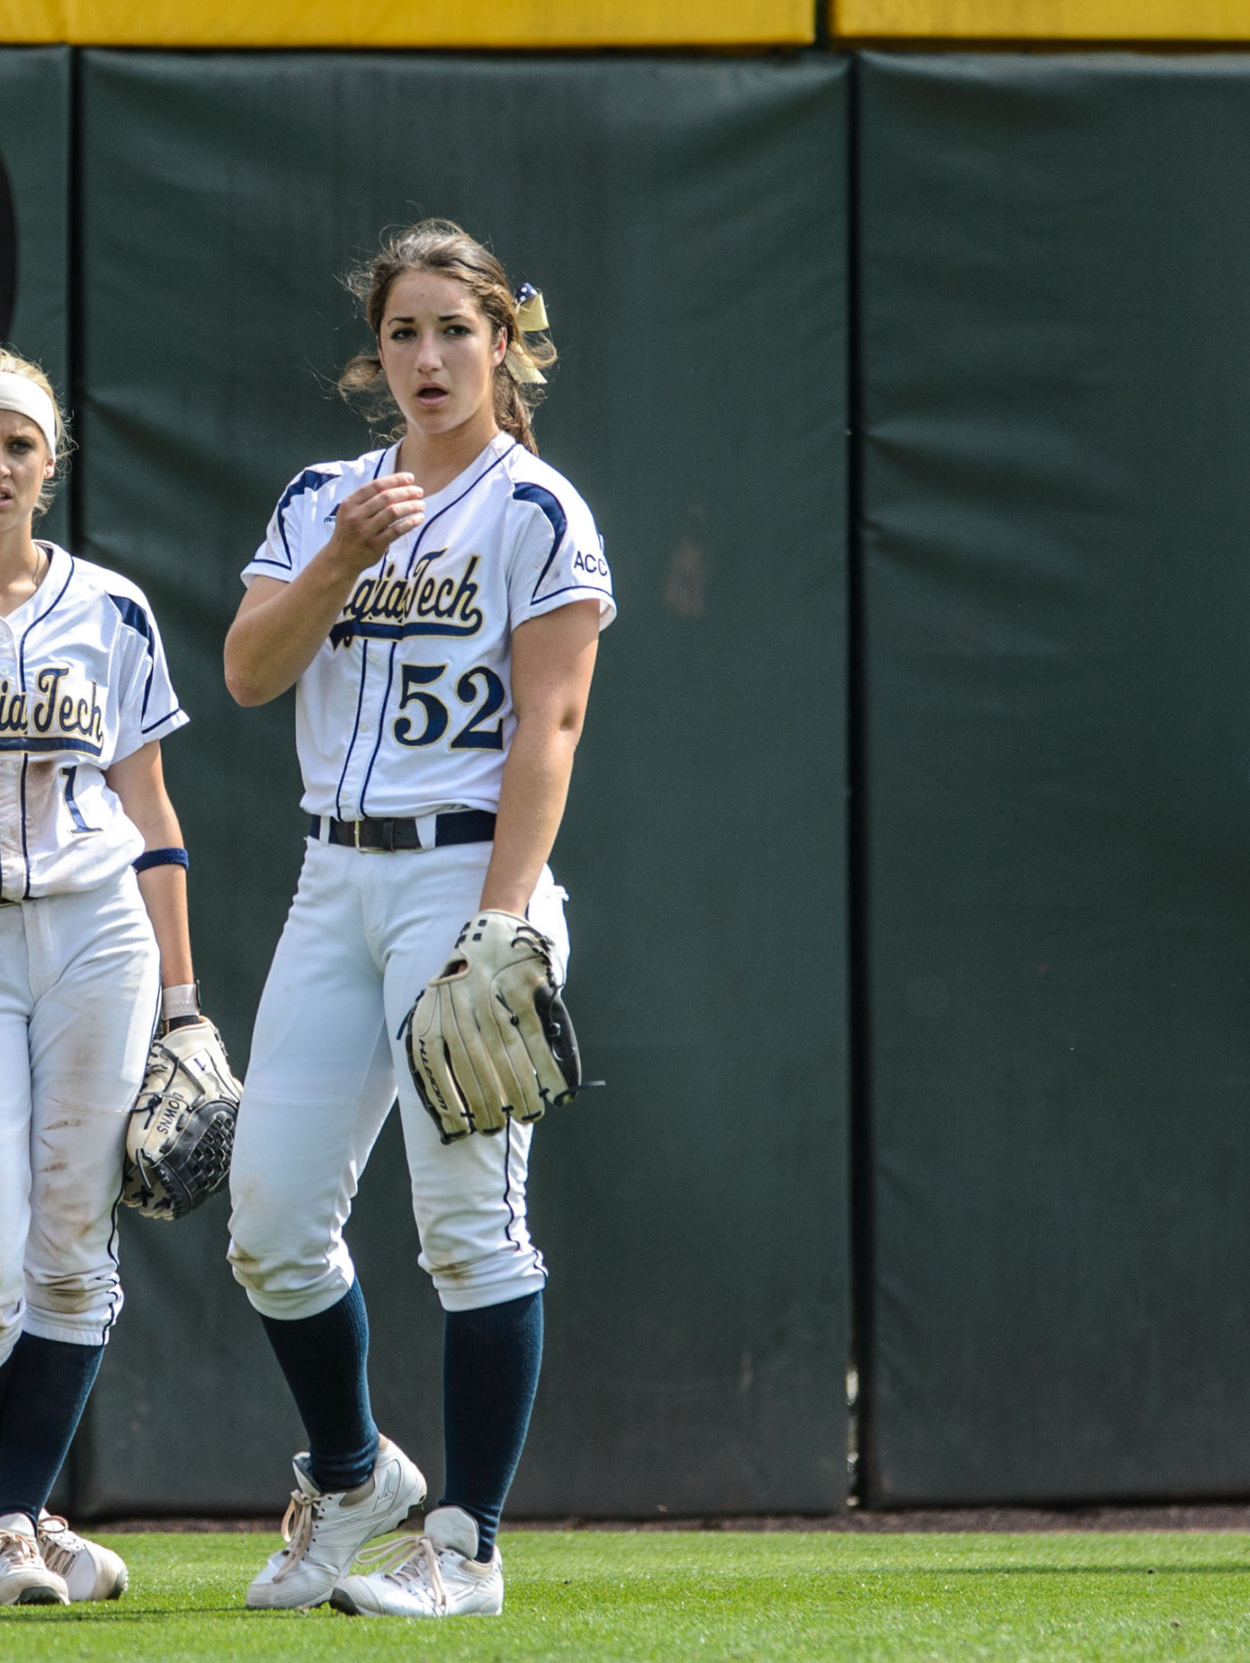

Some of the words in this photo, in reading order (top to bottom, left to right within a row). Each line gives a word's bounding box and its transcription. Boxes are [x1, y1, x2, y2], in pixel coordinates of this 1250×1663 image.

[404, 547, 484, 622] Tech
[573, 549, 608, 577] ACC
[32, 667, 105, 744] Tech
[393, 663, 506, 752] 52
[60, 765, 105, 835] 1
